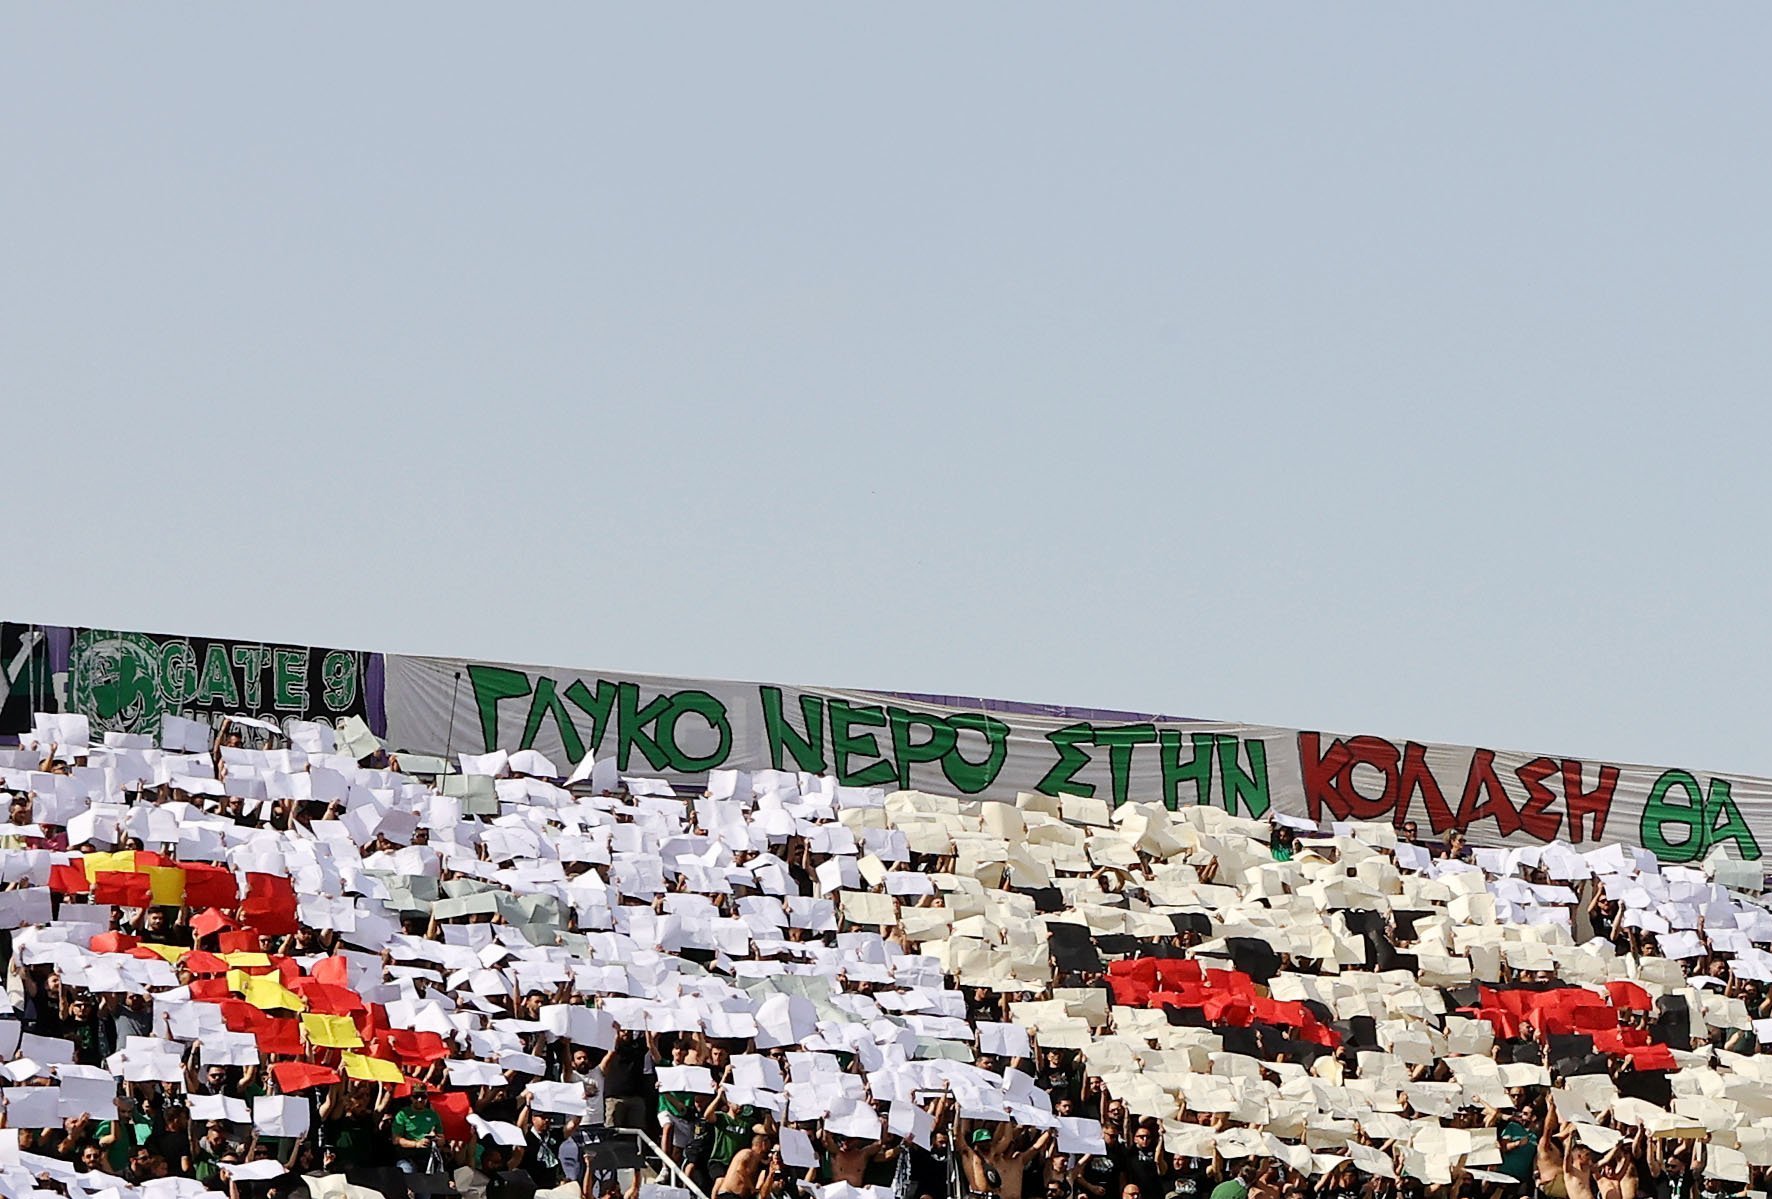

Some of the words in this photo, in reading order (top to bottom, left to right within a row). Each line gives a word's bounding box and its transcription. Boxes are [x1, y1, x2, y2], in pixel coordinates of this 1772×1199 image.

[159, 639, 310, 710] GATE
[322, 649, 357, 712] 9
[467, 664, 733, 775] ΓΛΥΚΟ
[759, 686, 1011, 794] ΝΕΡΟ
[1036, 722, 1271, 820] ΣΤΗΝ
[1297, 731, 1621, 844] ΚΟΛΑΣΗ
[1640, 769, 1763, 863] ΘΑ
